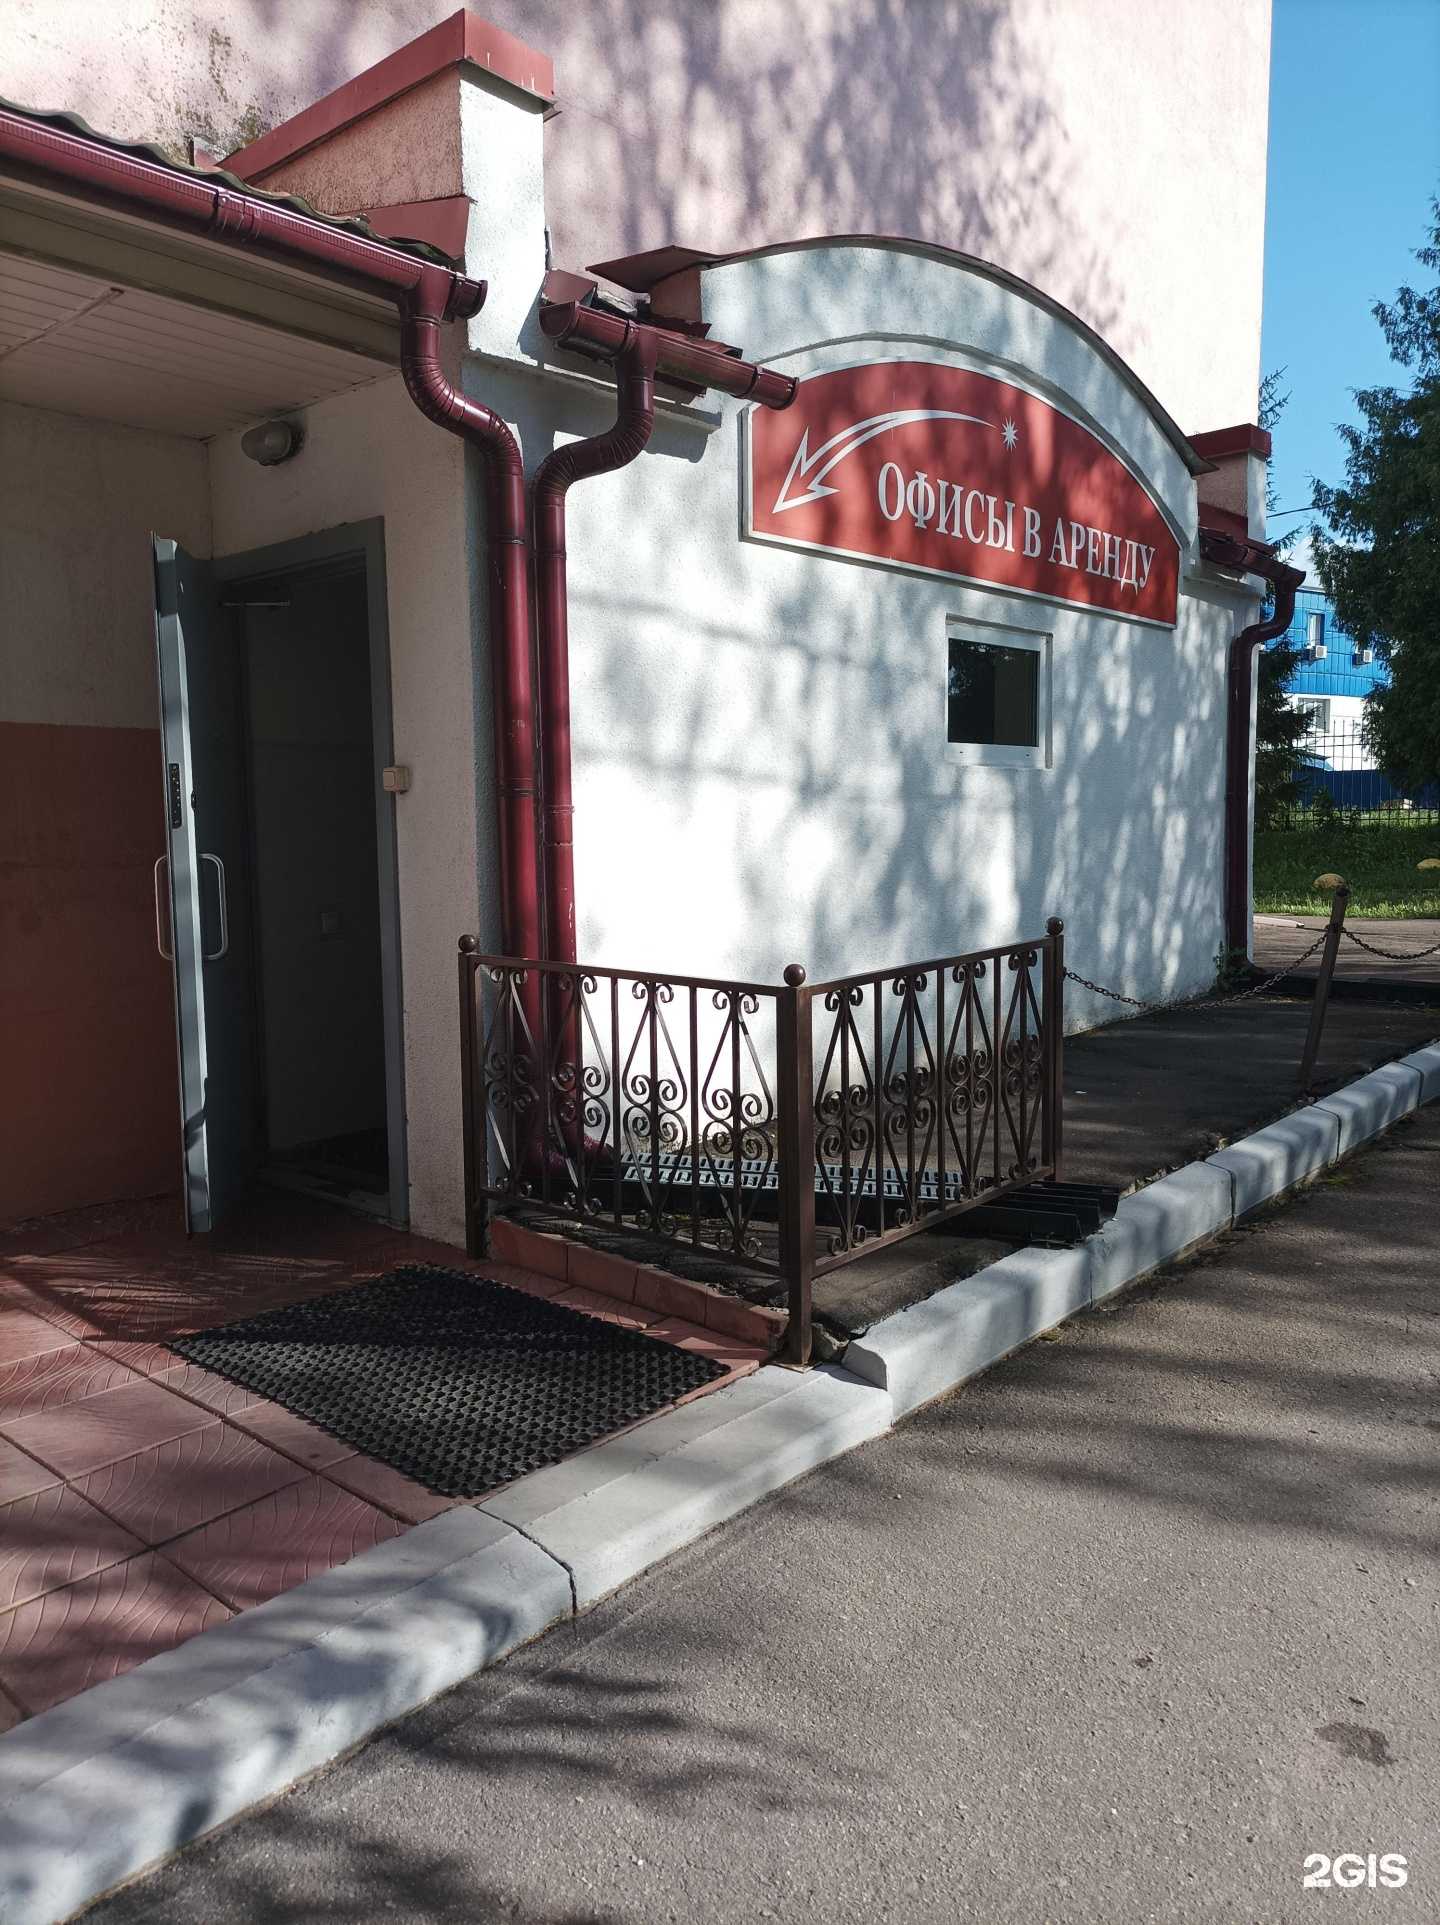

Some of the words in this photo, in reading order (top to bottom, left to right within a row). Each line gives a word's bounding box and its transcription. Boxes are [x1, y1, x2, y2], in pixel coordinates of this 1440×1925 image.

[878, 462, 1015, 553] ОФИСЫ
[1023, 506, 1042, 558] В
[1048, 517, 1155, 595] АРЕНДУ
